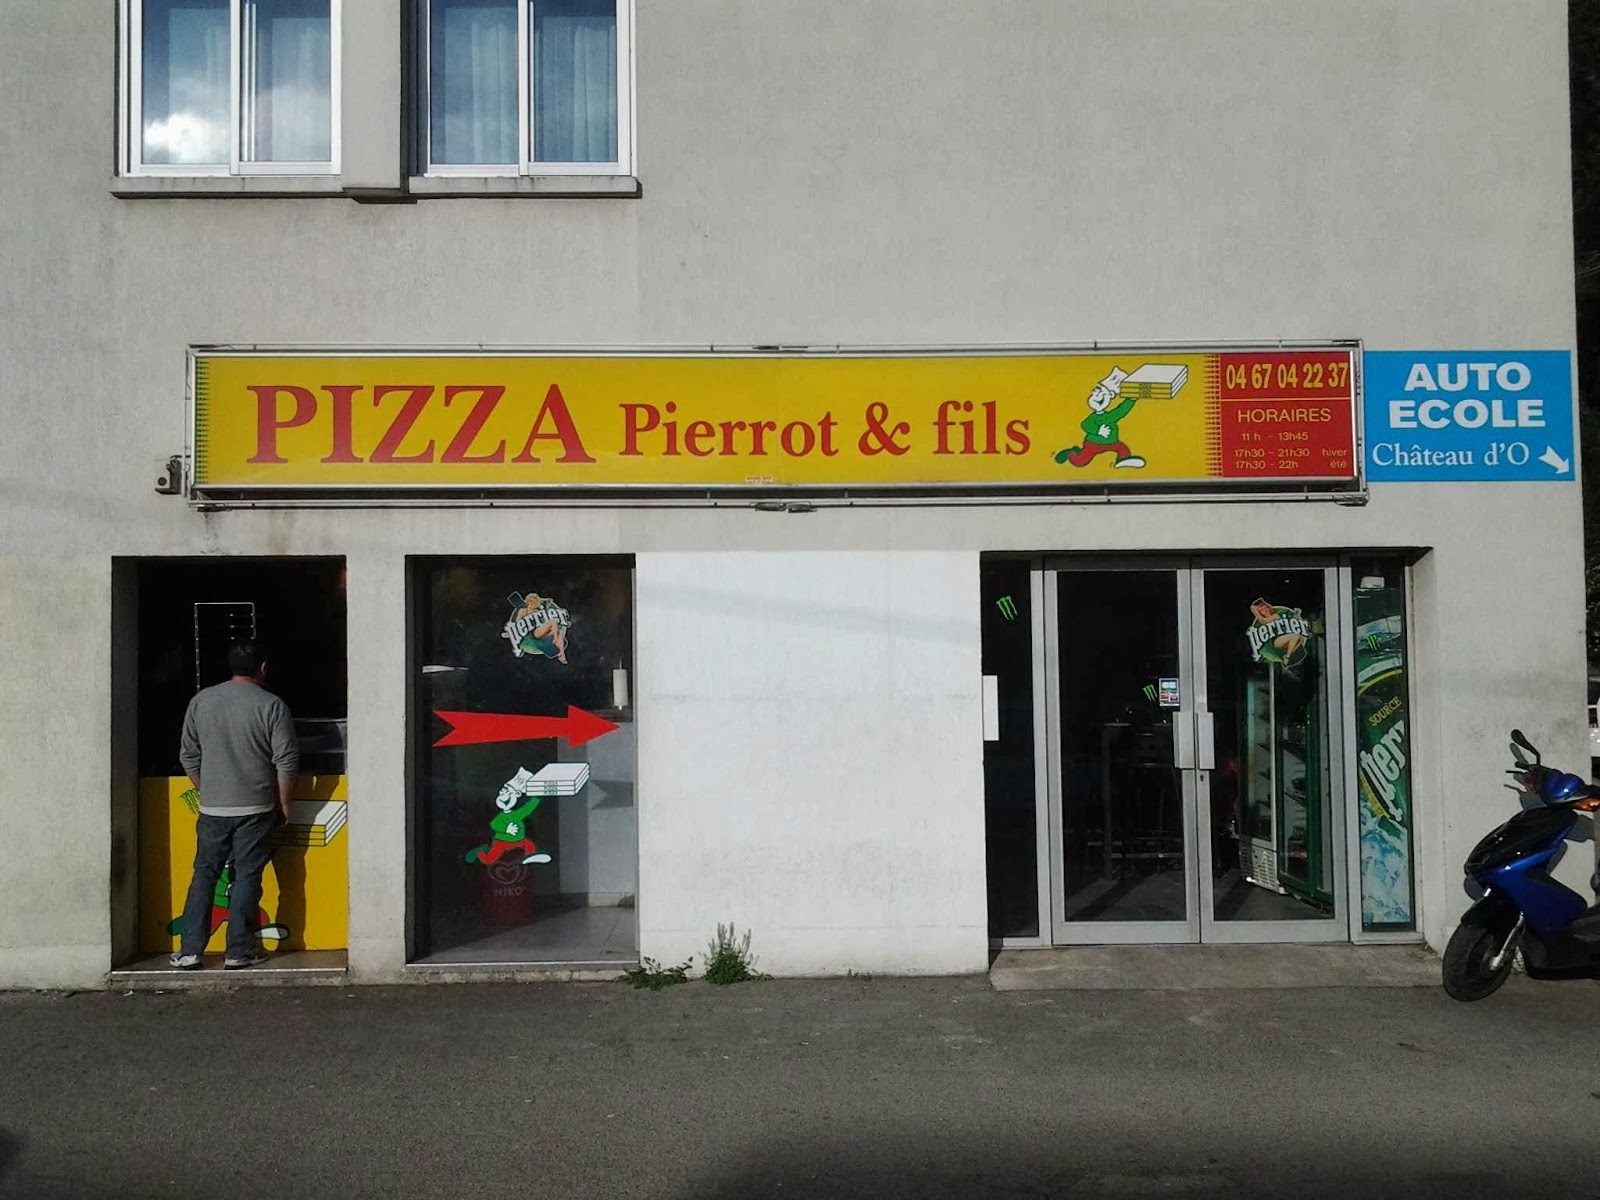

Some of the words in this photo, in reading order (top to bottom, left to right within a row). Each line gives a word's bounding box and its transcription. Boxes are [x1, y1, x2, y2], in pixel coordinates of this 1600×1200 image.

[1226, 364, 1247, 390] 04
[1251, 363, 1273, 390] 67
[1277, 363, 1298, 389] 04
[1303, 362, 1324, 388] 22
[1328, 362, 1349, 388] 37
[1404, 361, 1532, 392] AUTO
[246, 384, 597, 464] PIZZA
[619, 401, 839, 457] Pierrot
[858, 401, 911, 456] &
[932, 400, 1031, 456] fils
[1237, 407, 1332, 423] HORAIRES
[1389, 399, 1547, 429] ECOLE
[1277, 432, 1309, 441] 13h45
[1235, 448, 1265, 458] 17h30
[1277, 448, 1310, 457] 21h30
[1321, 448, 1348, 457] hiver
[1235, 460, 1266, 469] 17h30
[1278, 460, 1299, 469] 22h
[1372, 442, 1475, 467] Château
[1483, 441, 1531, 466] d'O
[1368, 696, 1403, 727] SOURCE
